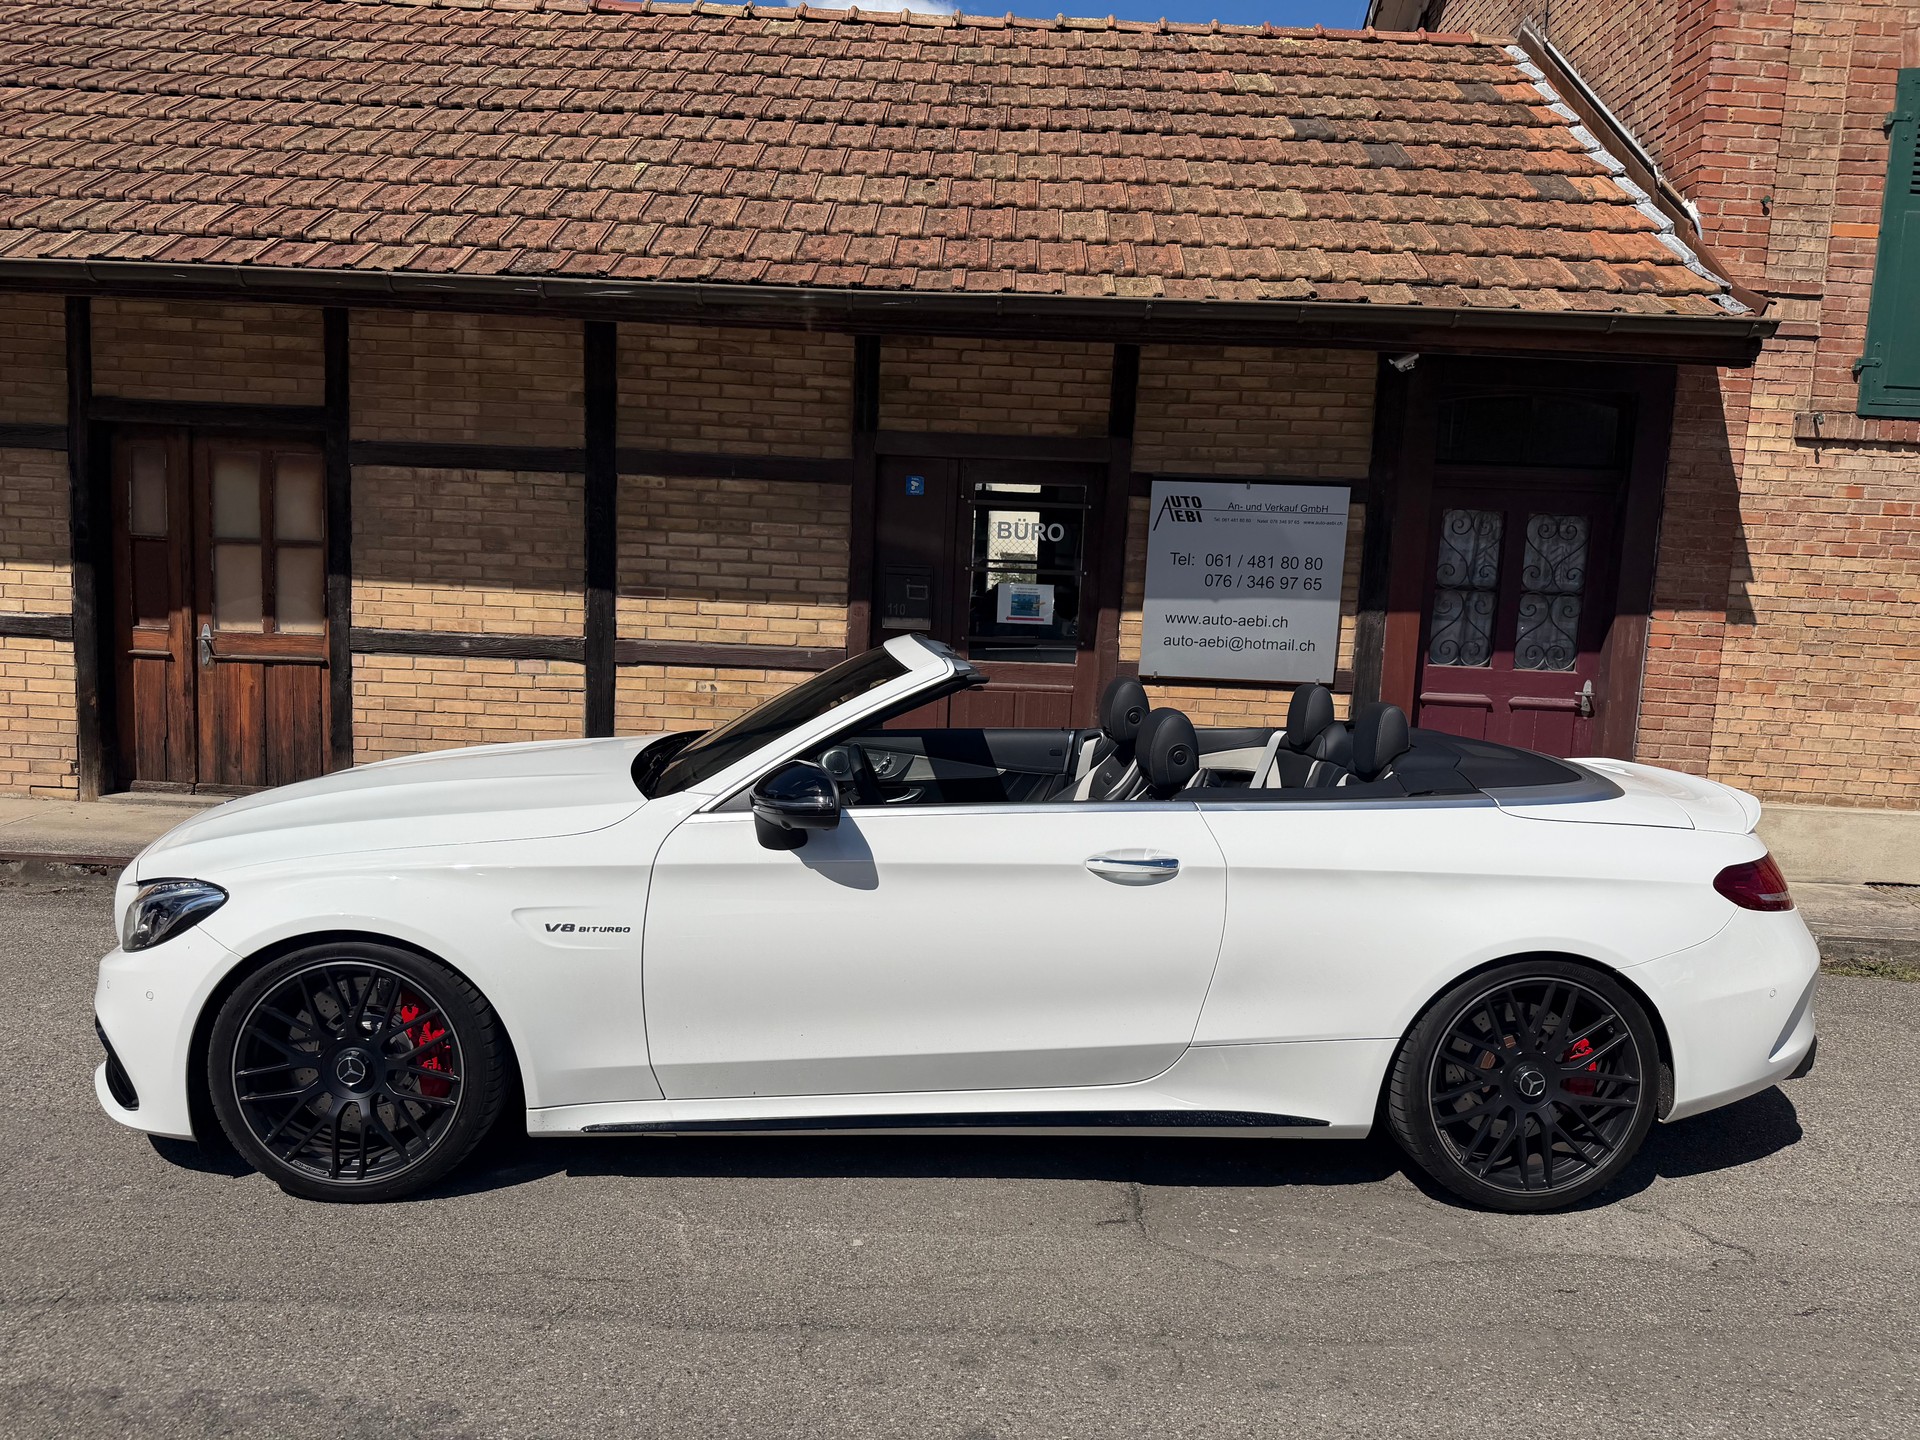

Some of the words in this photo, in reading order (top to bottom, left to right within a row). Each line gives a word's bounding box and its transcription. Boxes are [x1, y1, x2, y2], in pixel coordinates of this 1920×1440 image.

[1228, 502, 1243, 510] An-
[1265, 503, 1299, 512] Verkauf
[1300, 505, 1328, 513] GmbH
[997, 518, 1065, 542] BÜRO
[1170, 552, 1195, 565] Tel:
[1206, 554, 1231, 567] 061
[1238, 555, 1243, 567] /
[1247, 556, 1273, 568] 481
[1281, 556, 1299, 569] 80
[1305, 557, 1322, 570] 80
[1205, 574, 1232, 587] 076
[1237, 575, 1242, 588] /
[1247, 576, 1274, 589] 346
[1280, 577, 1298, 589] 97
[1304, 578, 1321, 590] 65
[1165, 615, 1288, 628] www.auto-aebi.ch
[1164, 636, 1315, 651] auto-aebi@hotmail.ch
[545, 923, 575, 932] V8
